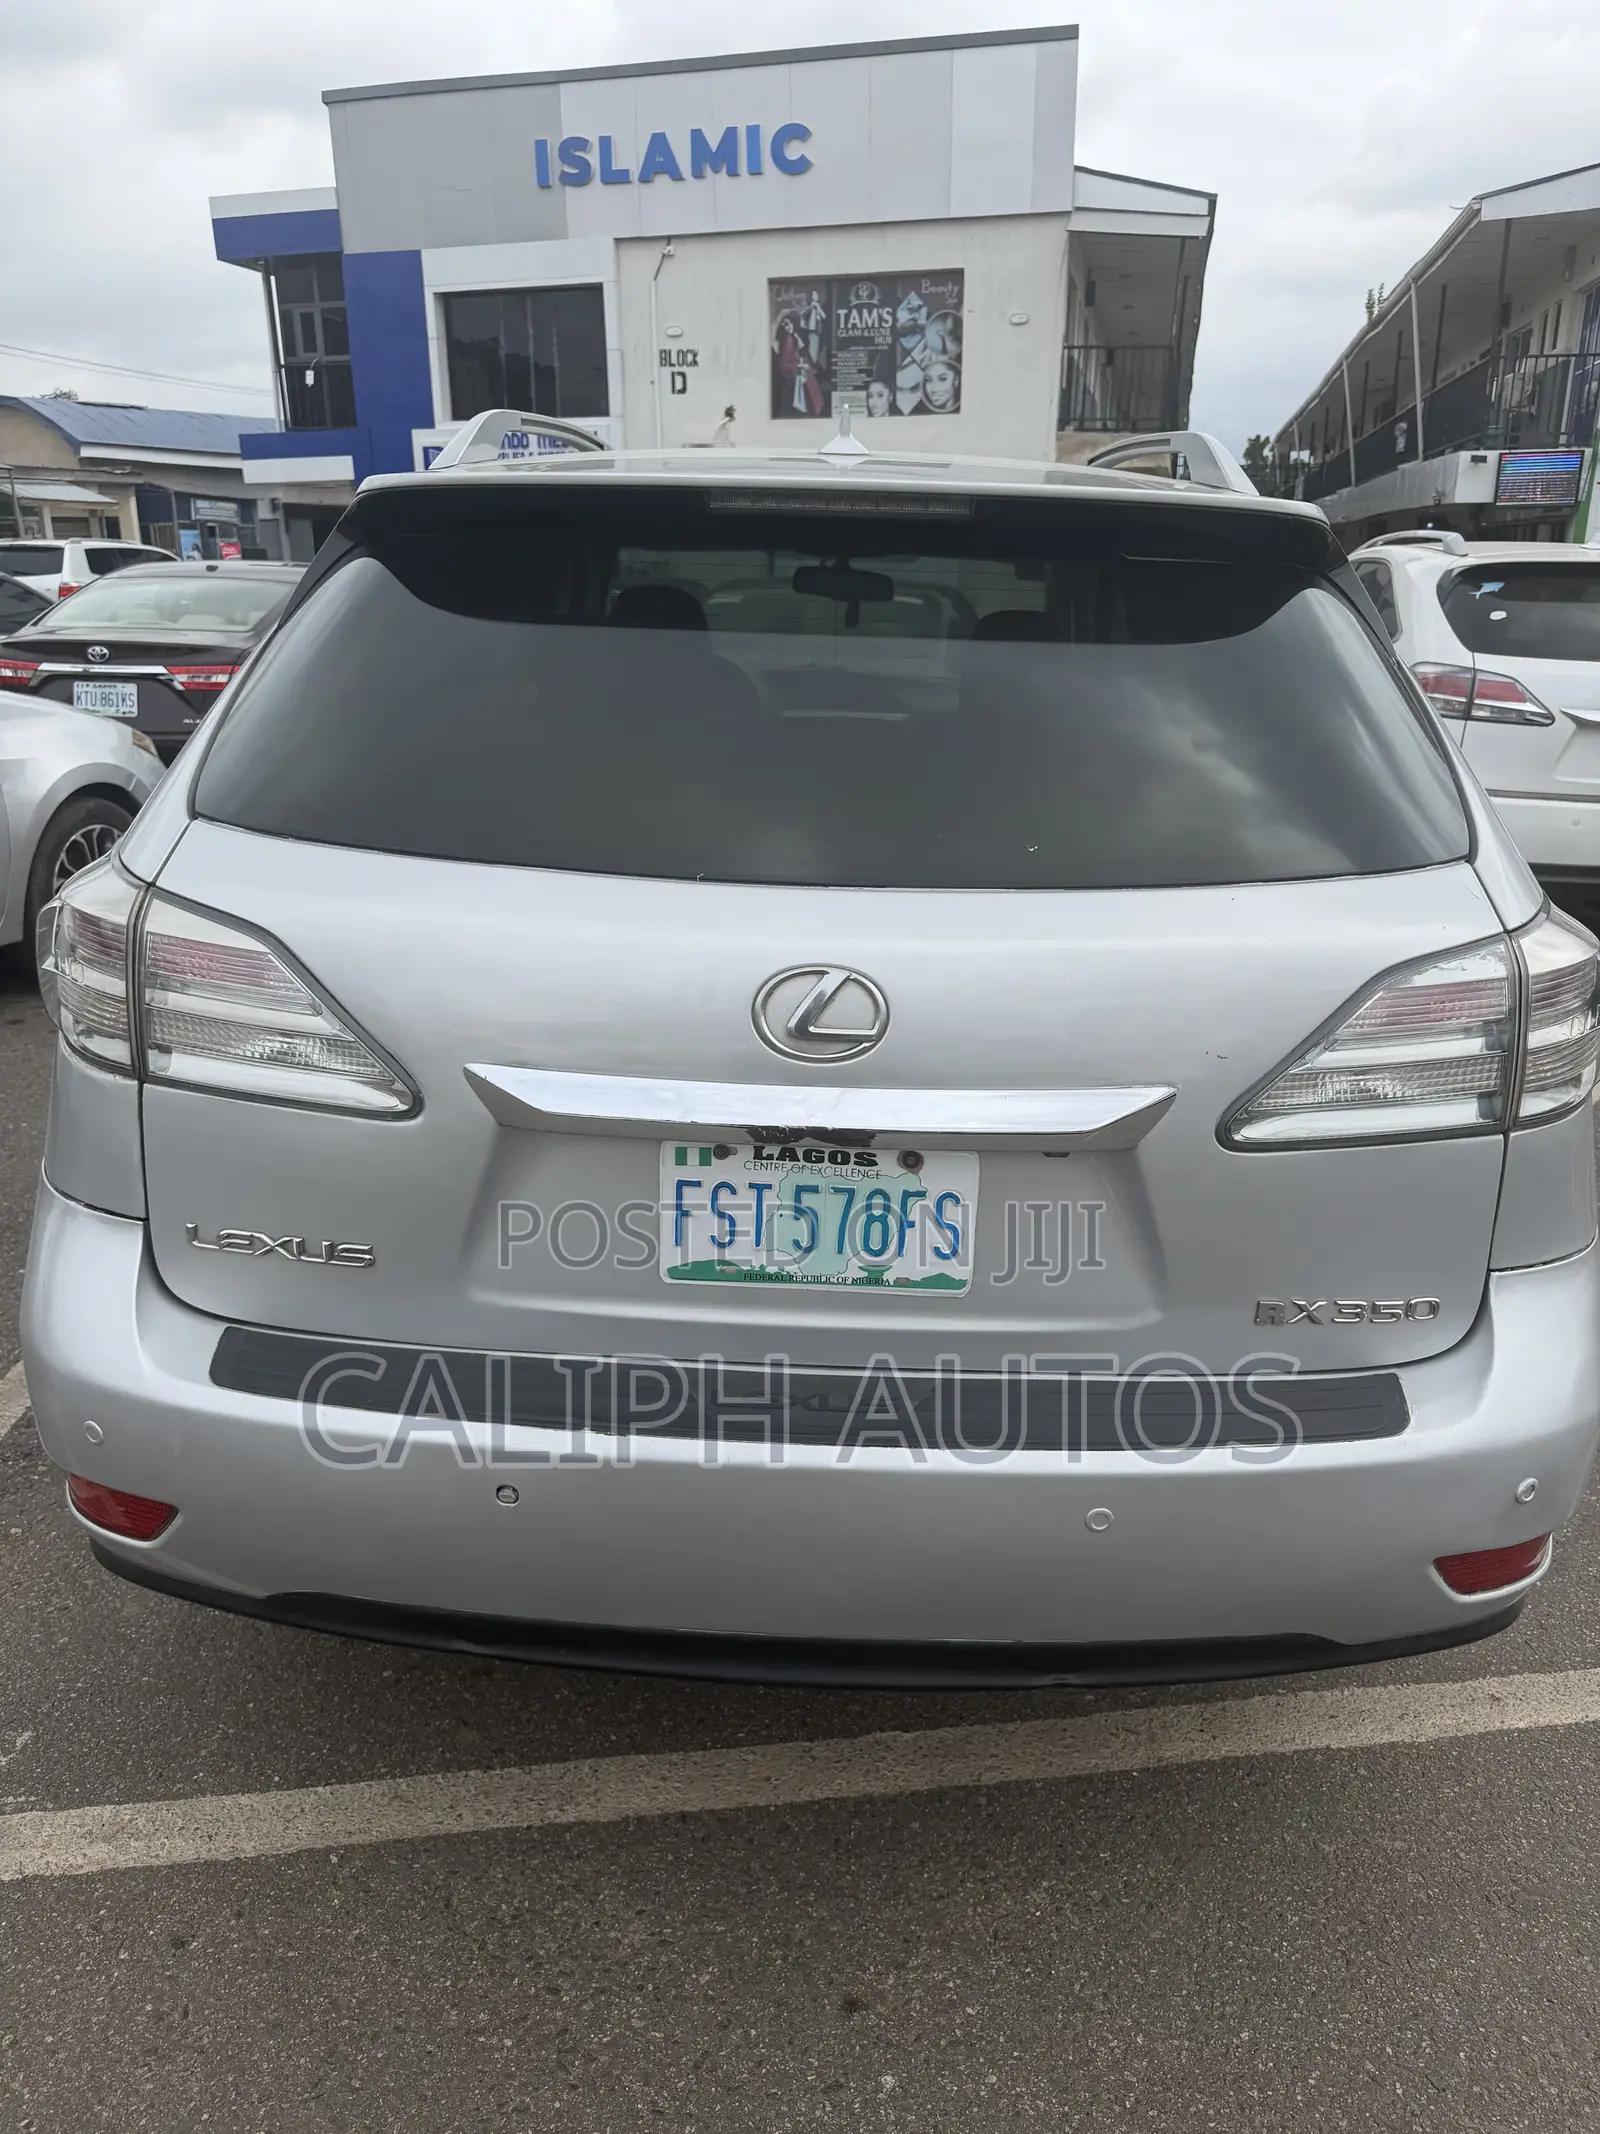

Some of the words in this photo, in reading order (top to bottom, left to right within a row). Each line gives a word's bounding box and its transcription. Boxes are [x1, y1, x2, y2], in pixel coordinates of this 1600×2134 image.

[534, 122, 814, 188] ISLAMIC
[837, 307, 893, 329] TAM'S
[659, 348, 699, 368] BLOCK
[671, 371, 687, 395] D
[752, 1145, 879, 1167] LAGOS
[743, 1160, 789, 1173] CENTRE
[791, 1163, 810, 1174] OF
[810, 1163, 883, 1180] EXCELLENCE
[185, 1222, 375, 1268] LEXUS
[744, 1272, 787, 1282] FEDERAL
[788, 1273, 835, 1284] REPUBLIC
[837, 1275, 850, 1284] OF
[851, 1276, 891, 1286] NIGERIA
